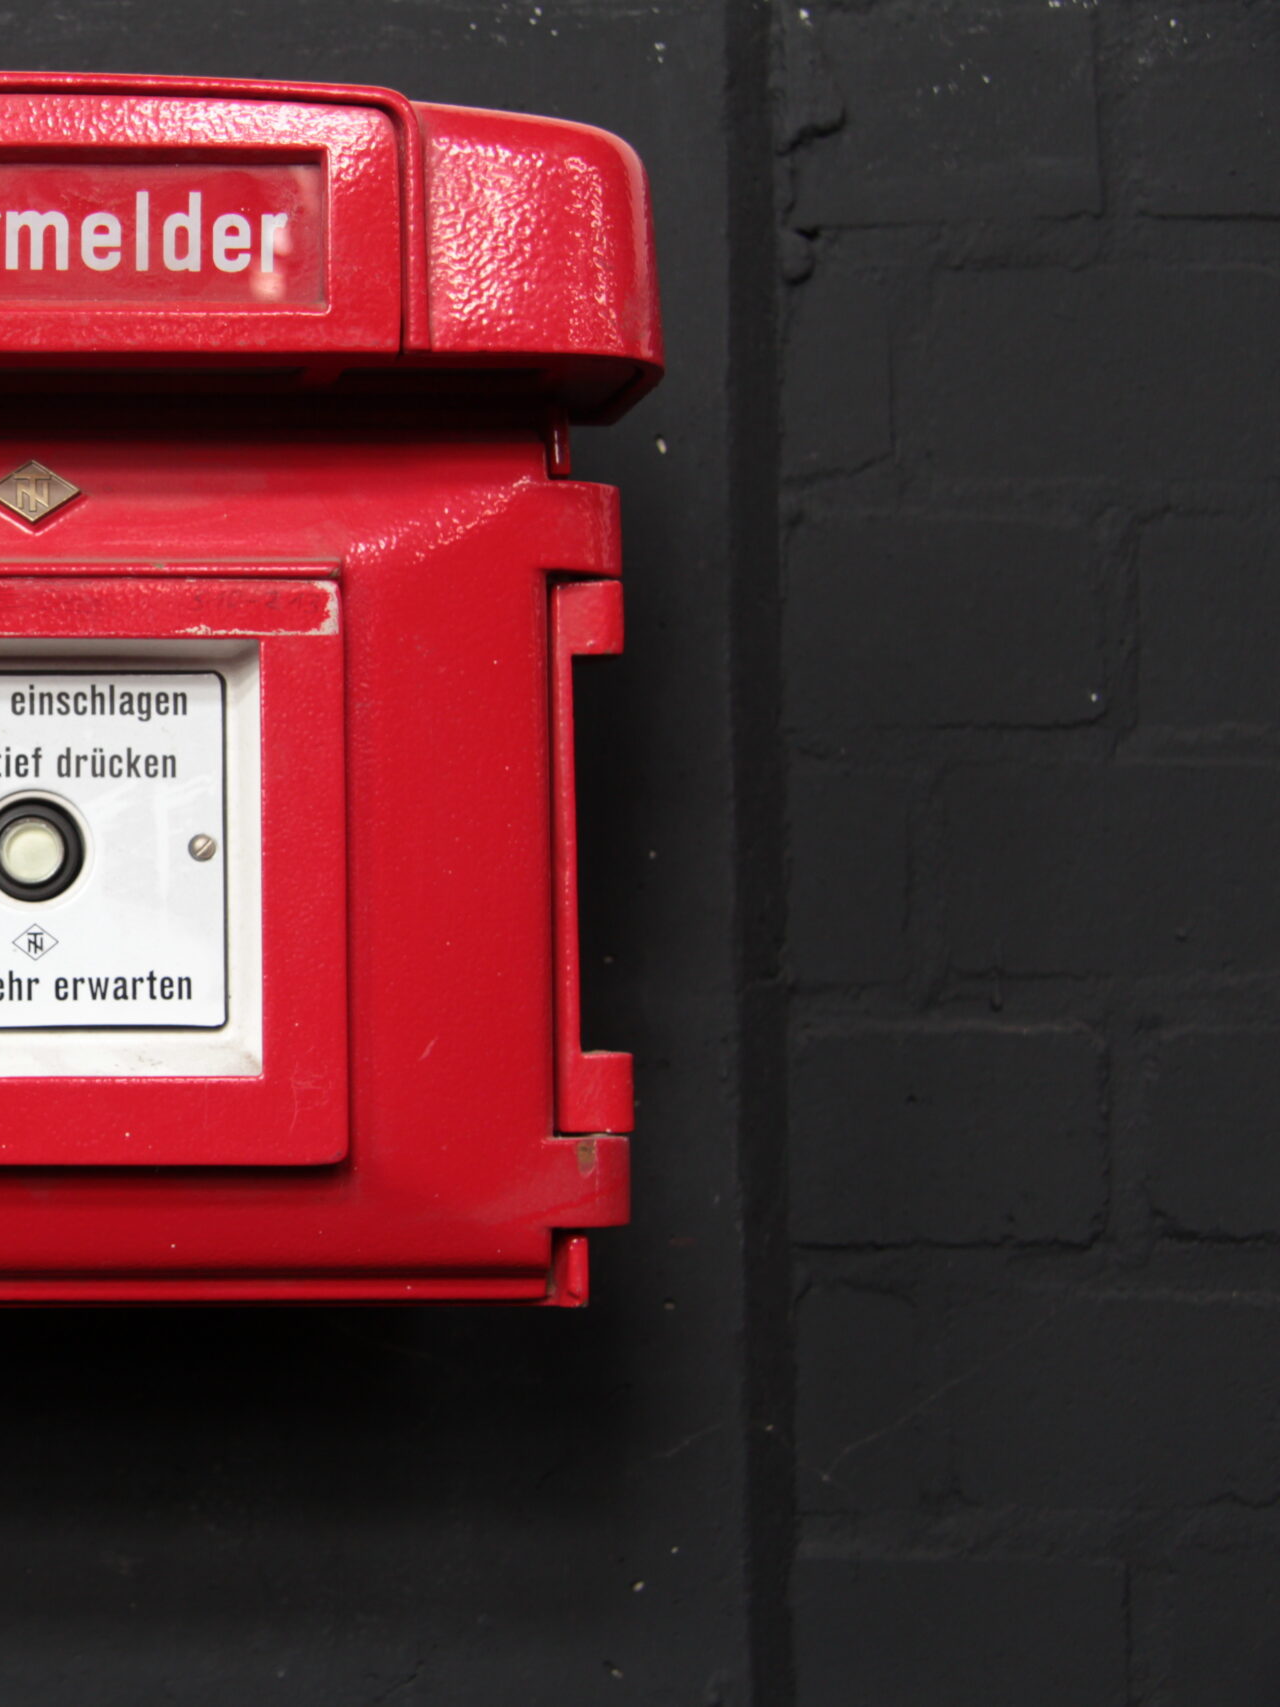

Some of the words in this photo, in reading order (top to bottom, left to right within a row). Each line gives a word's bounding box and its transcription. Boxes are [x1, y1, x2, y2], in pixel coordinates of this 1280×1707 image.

[11, 683, 188, 722] einschlagen
[57, 746, 176, 778] drücken
[54, 970, 192, 1001] erwarten
